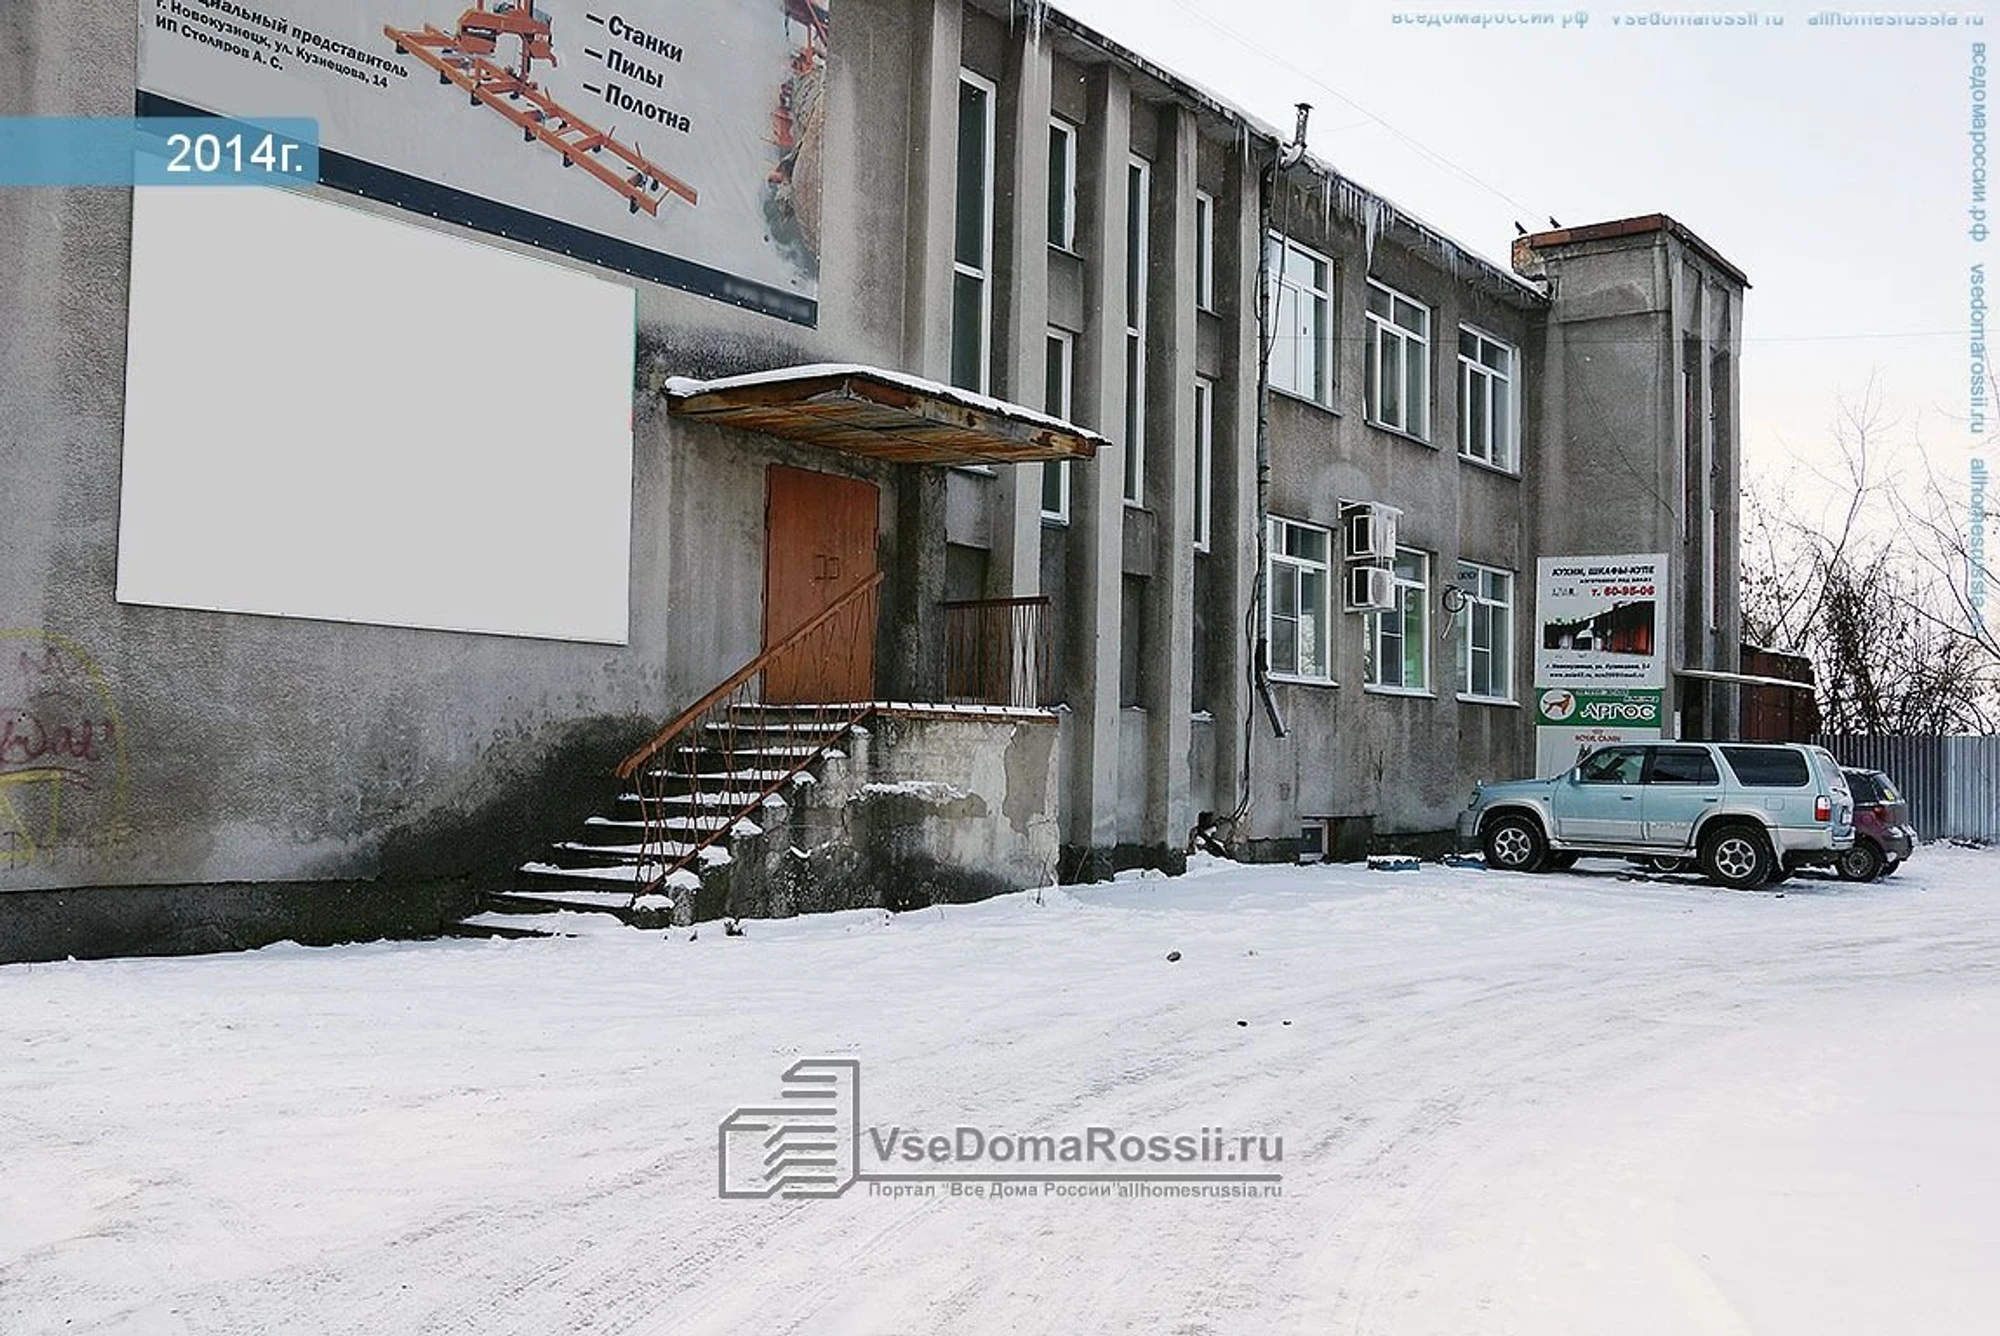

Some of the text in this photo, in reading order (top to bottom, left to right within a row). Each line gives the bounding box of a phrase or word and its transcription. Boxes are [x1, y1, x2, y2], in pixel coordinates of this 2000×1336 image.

[156, 14, 283, 71] ИП Столяров А. С.
[171, 3, 271, 48] Новокузнецк,
[274, 40, 293, 56] ул.
[296, 46, 370, 84] Кузнецова,
[372, 73, 388, 88] 14
[291, 26, 409, 78] представитель
[609, 15, 682, 62] Станки
[607, 48, 663, 88] Пилы
[605, 83, 690, 133] Полотна
[1580, 703, 1657, 720] АРГОС
